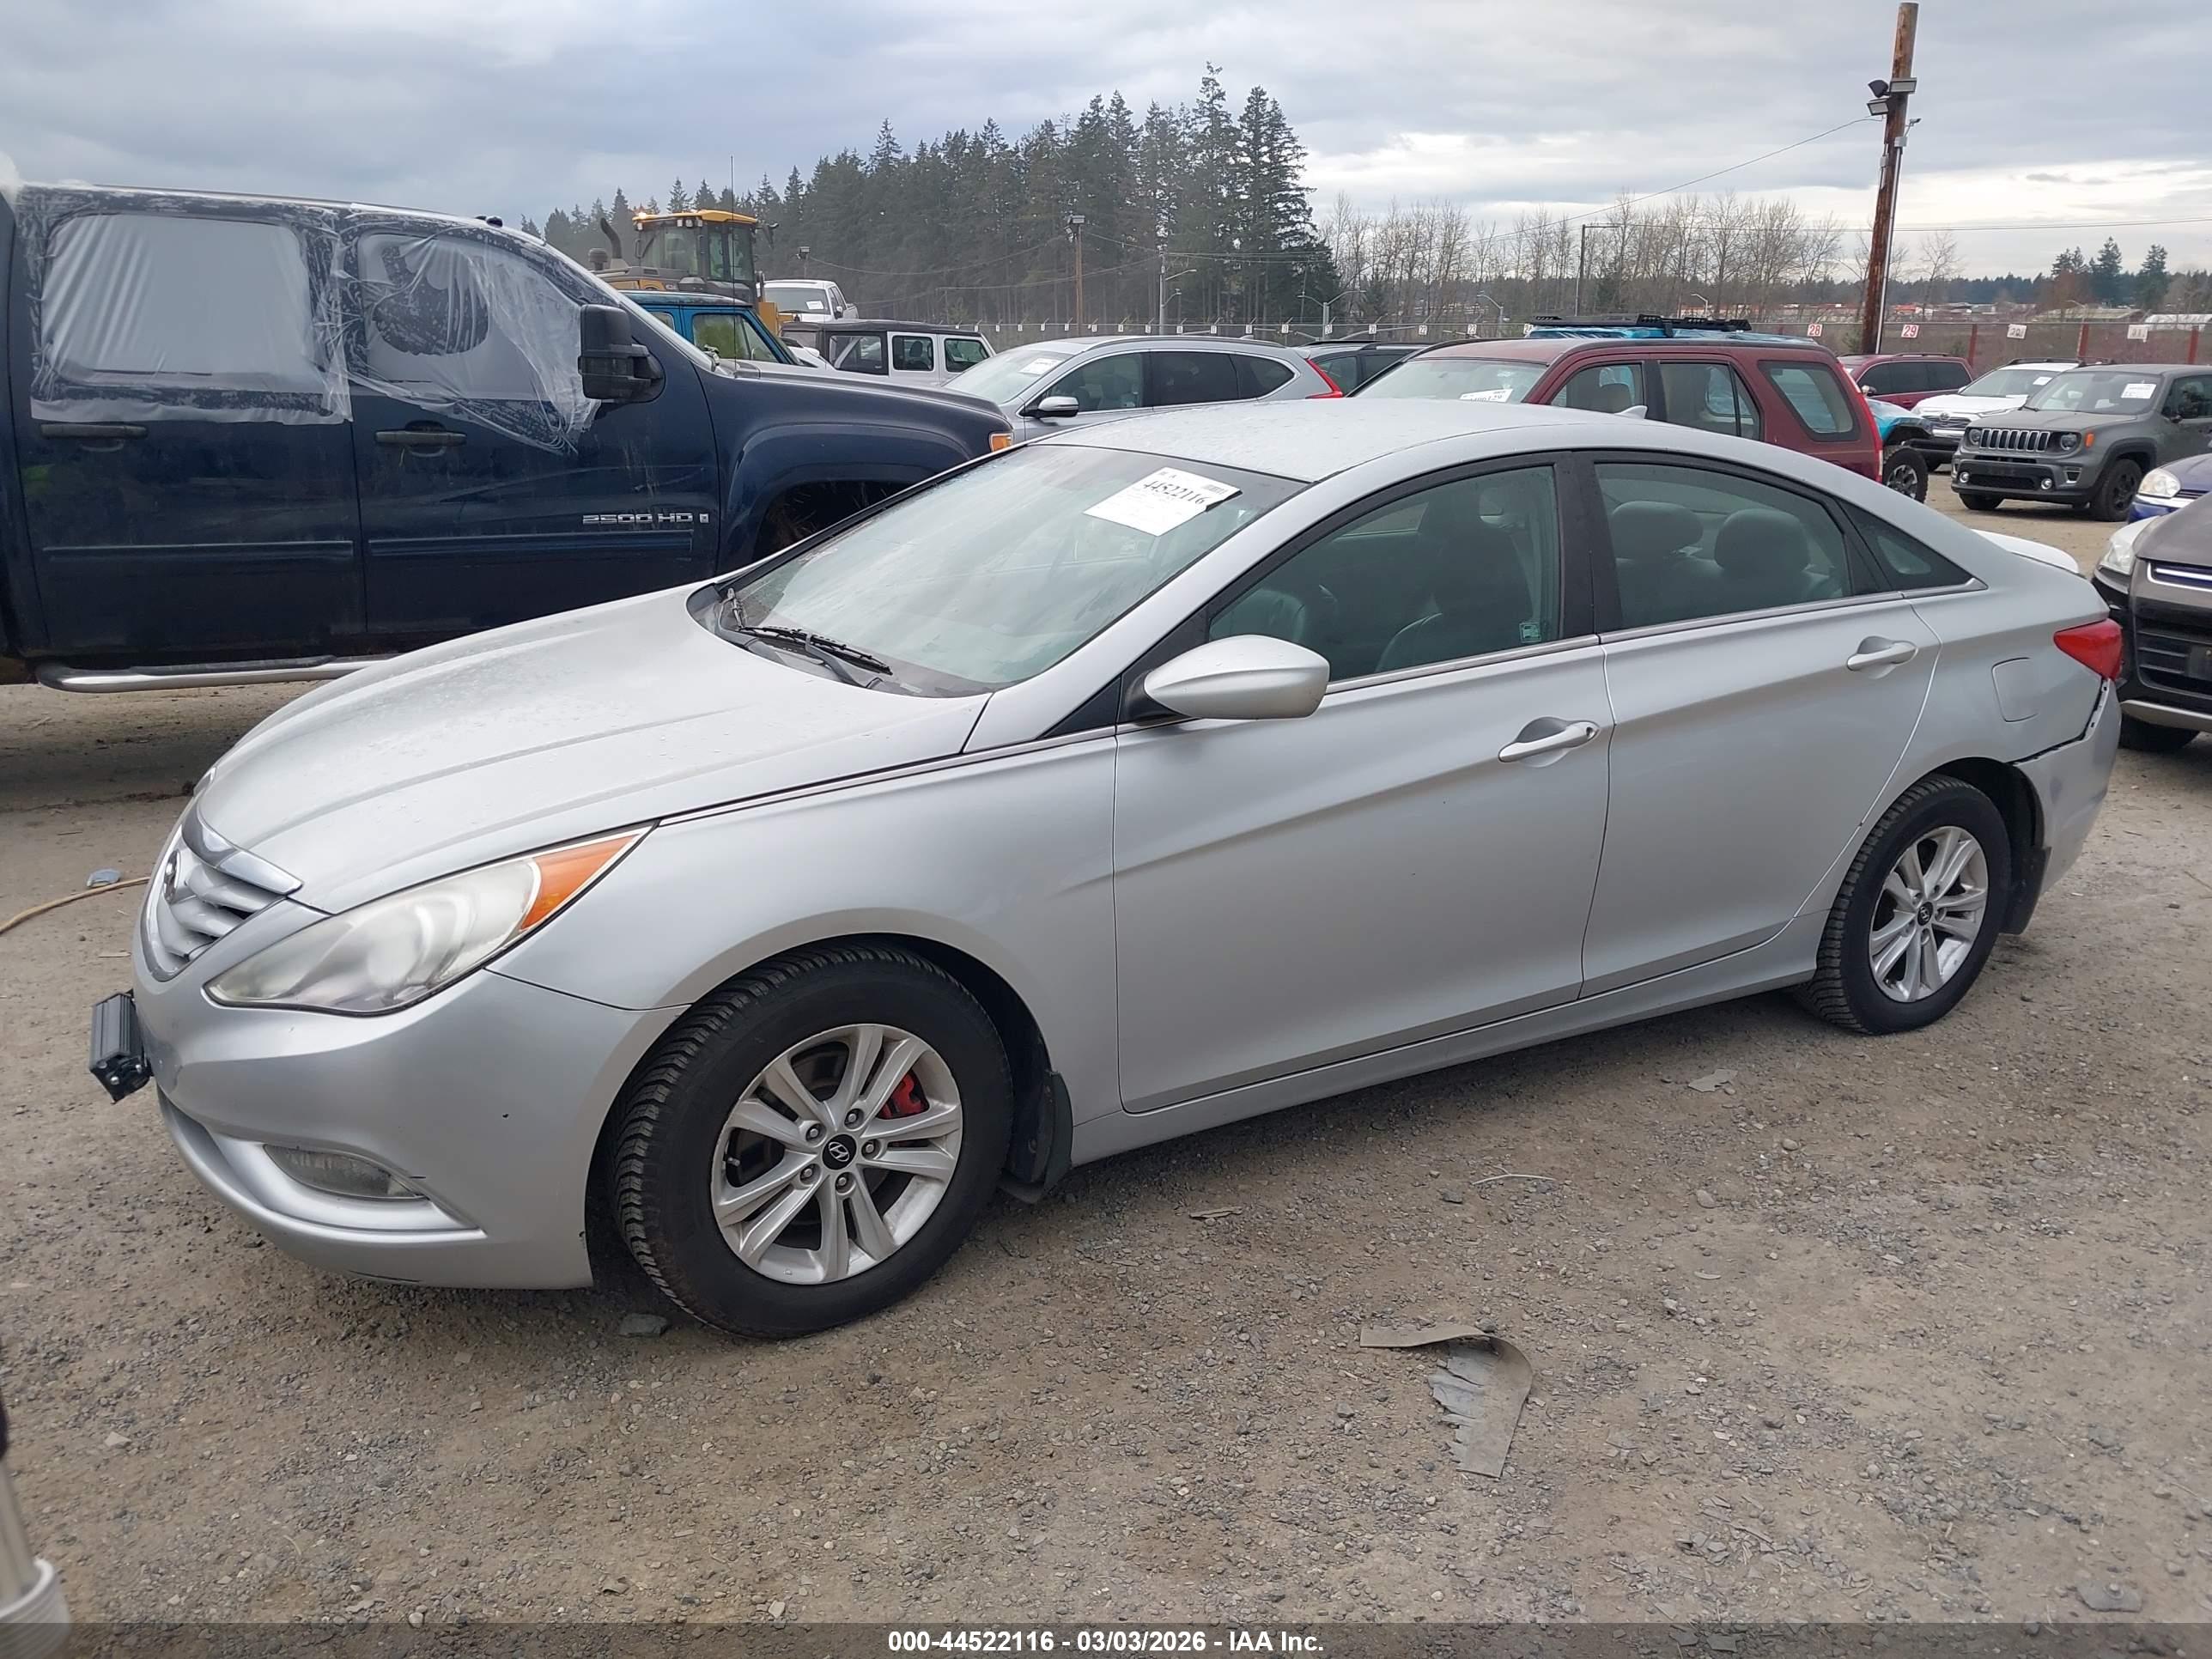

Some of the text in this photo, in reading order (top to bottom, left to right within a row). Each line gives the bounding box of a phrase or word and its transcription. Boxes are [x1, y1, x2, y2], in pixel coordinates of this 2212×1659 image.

[1809, 325, 1820, 336] 28
[1903, 325, 1917, 337] 29
[1143, 480, 1211, 505] 44522116
[582, 513, 694, 525] 2500 HD
